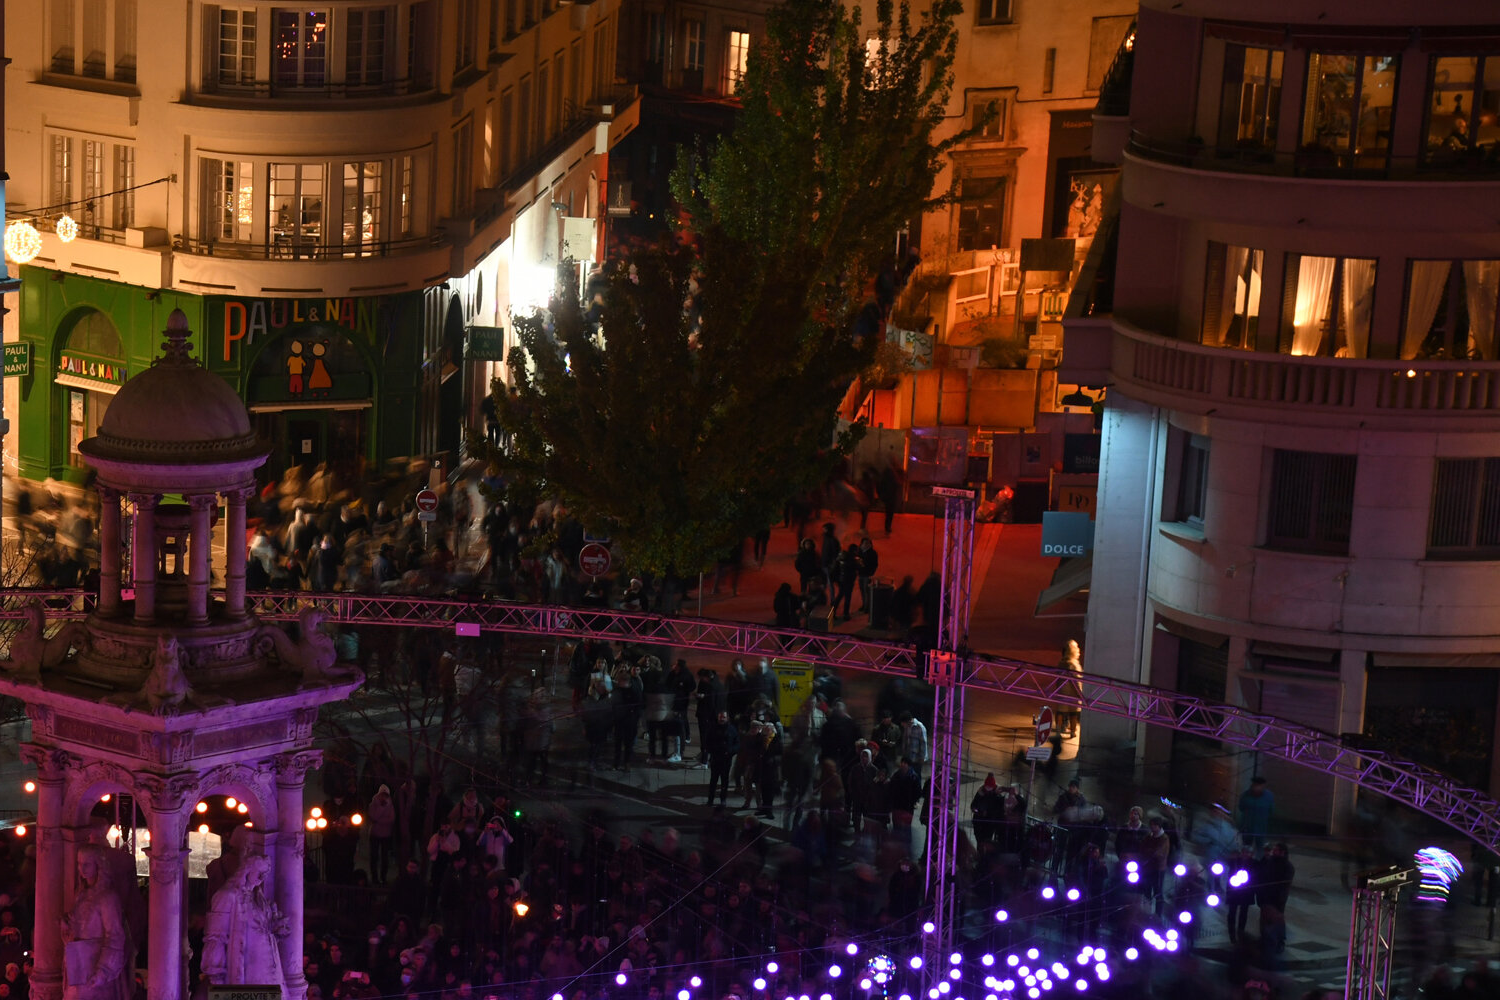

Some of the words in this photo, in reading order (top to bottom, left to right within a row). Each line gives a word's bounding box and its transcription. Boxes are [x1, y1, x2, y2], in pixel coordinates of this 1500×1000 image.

[223, 298, 305, 361] PAUL
[308, 306, 321, 322] &
[5, 346, 27, 356] PAUL
[4, 363, 28, 373] NANY
[61, 355, 88, 375] PAUL
[89, 362, 96, 377] &
[98, 363, 127, 383] NANY
[1044, 544, 1084, 555] DOLCE
[231, 992, 268, 1000] PROLYTE
